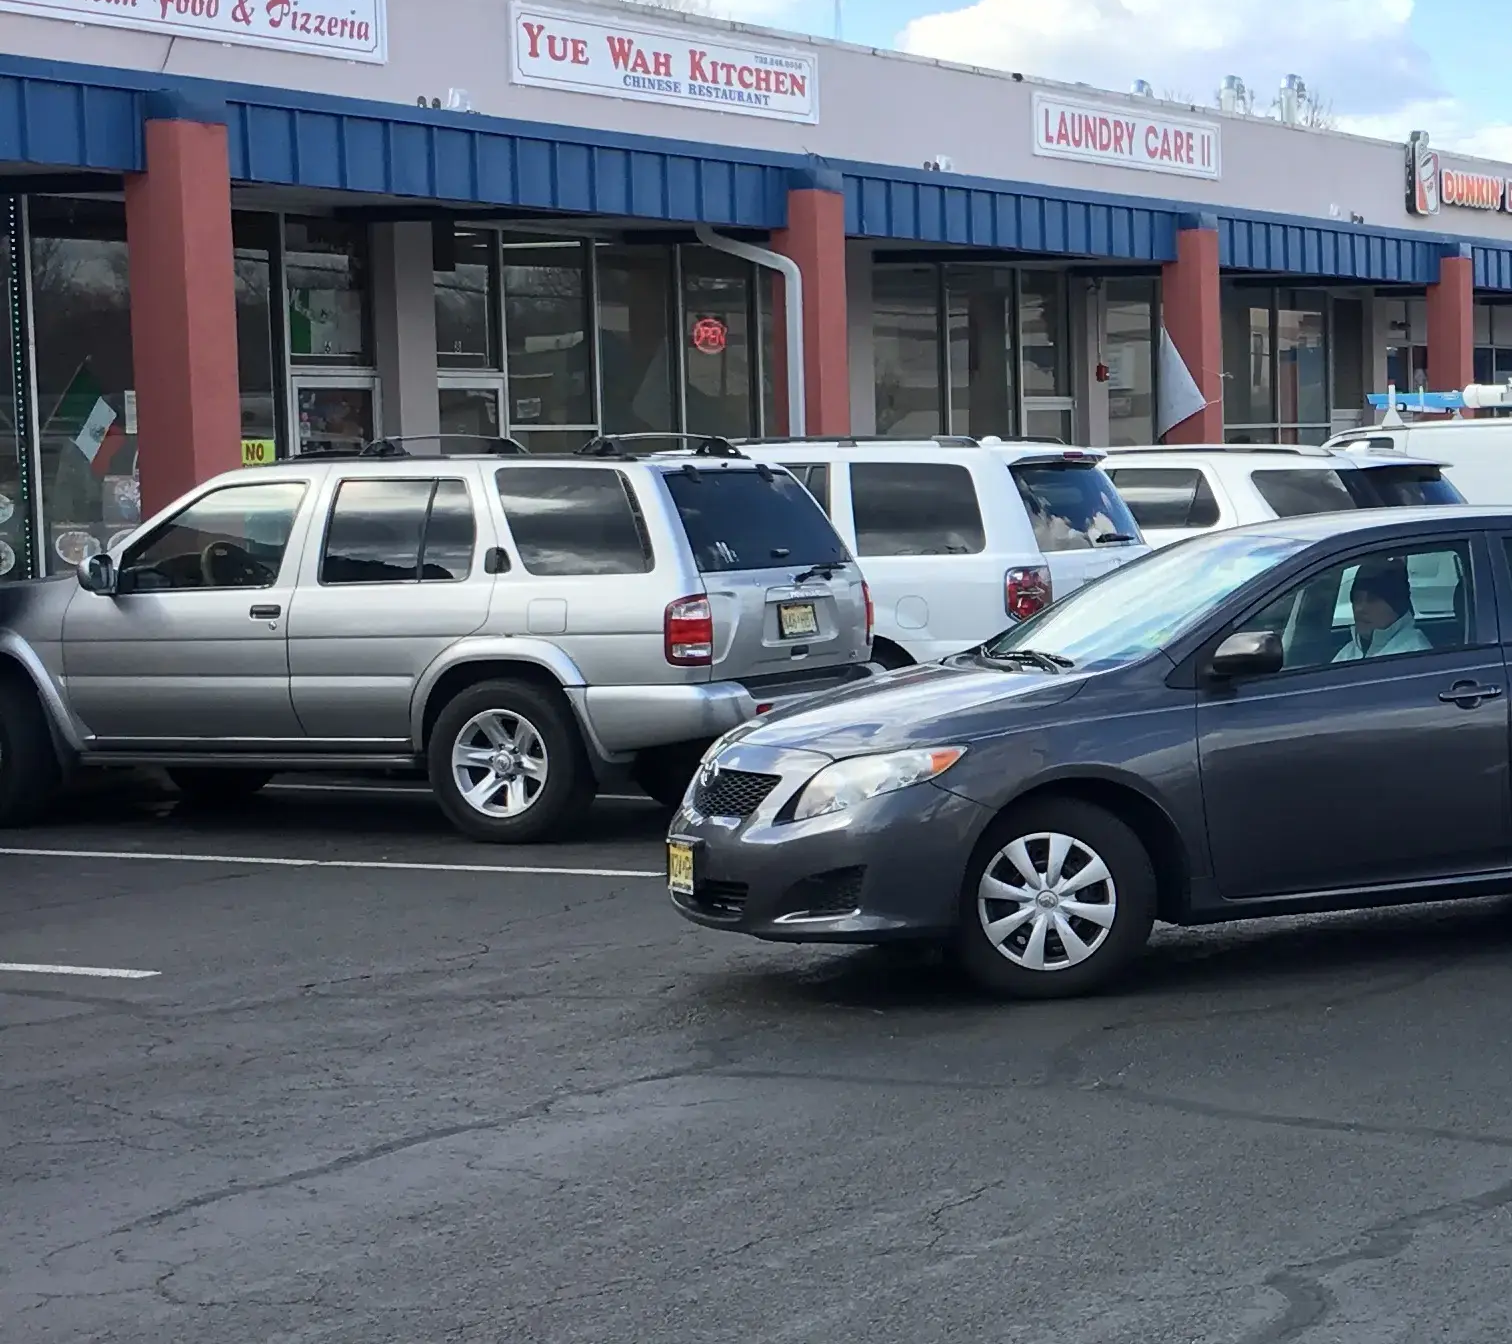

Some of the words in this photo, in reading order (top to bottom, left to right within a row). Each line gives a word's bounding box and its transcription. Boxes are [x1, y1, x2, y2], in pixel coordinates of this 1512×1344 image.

[522, 22, 590, 66] YUE
[606, 36, 672, 77] WAH
[688, 49, 807, 98] KITCHEN
[622, 74, 681, 94] CHINESE
[687, 83, 771, 106] RESTAURANT
[1044, 108, 1136, 155] LAUNDRY
[1145, 125, 1194, 165] CARE
[1201, 135, 1211, 167] II
[1441, 169, 1503, 211] DUNKIN'
[245, 443, 264, 461] NO
